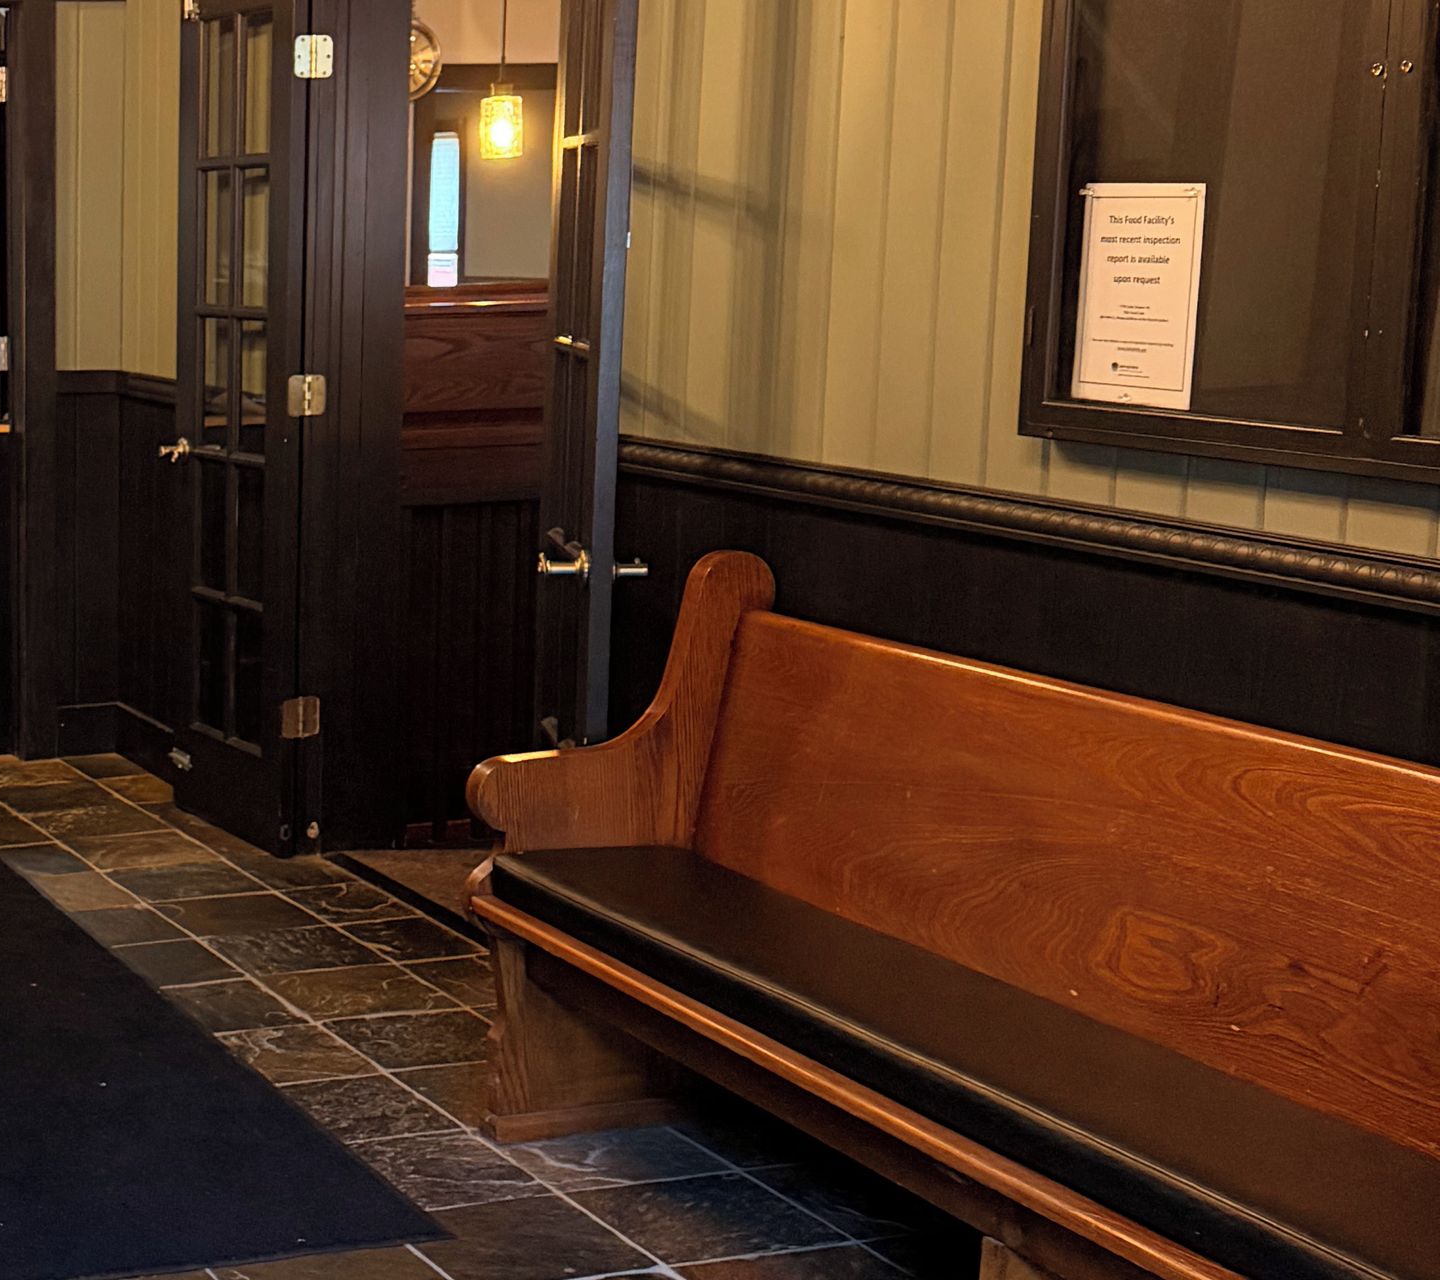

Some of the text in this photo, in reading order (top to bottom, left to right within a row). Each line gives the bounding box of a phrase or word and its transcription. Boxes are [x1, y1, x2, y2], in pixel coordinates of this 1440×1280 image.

[1108, 215, 1175, 227] This Food Facility's
[1119, 236, 1141, 244] recent
[1143, 235, 1181, 245] inspection
[1107, 255, 1170, 264] report is available
[1113, 276, 1160, 285] upon request
